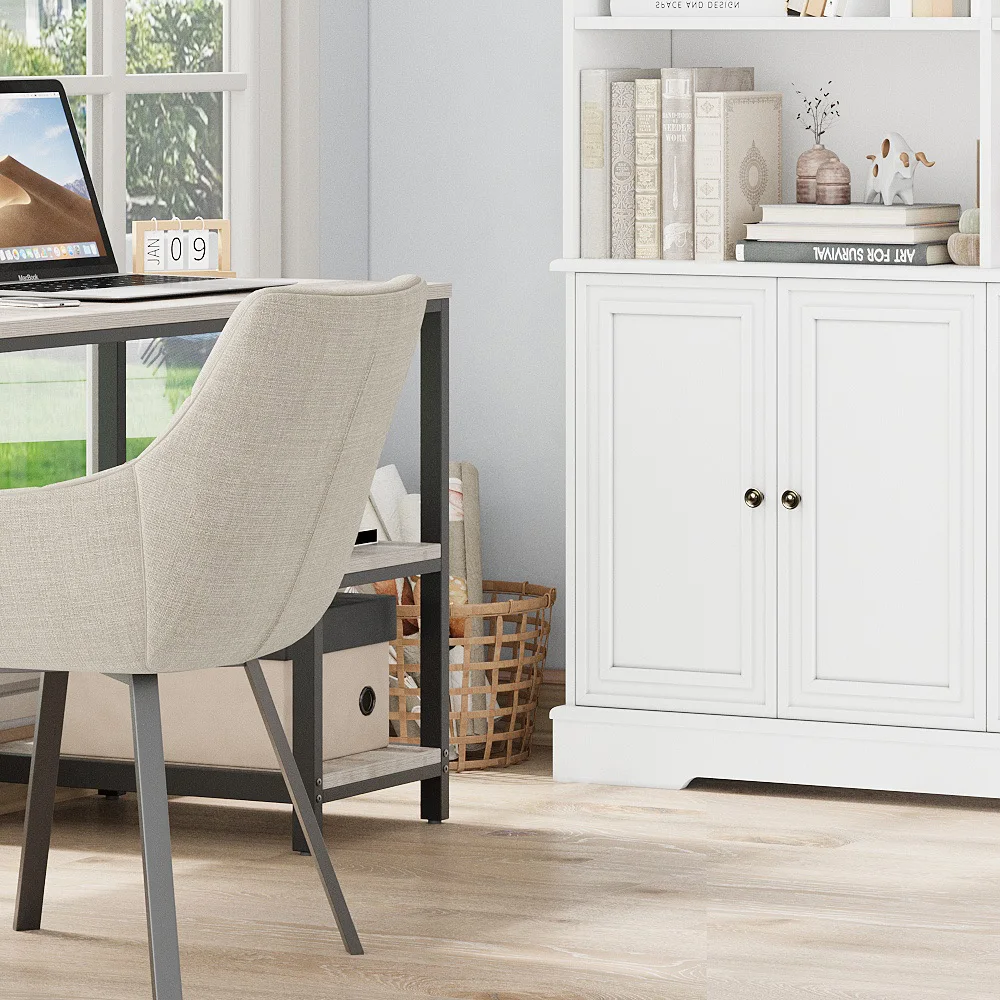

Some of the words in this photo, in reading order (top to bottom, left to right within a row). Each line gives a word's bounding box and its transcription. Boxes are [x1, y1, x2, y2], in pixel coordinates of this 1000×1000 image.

[148, 238, 160, 266] JAN
[812, 246, 864, 262] SURVIVAL
[866, 248, 890, 262] FOR
[894, 248, 916, 263] ART
